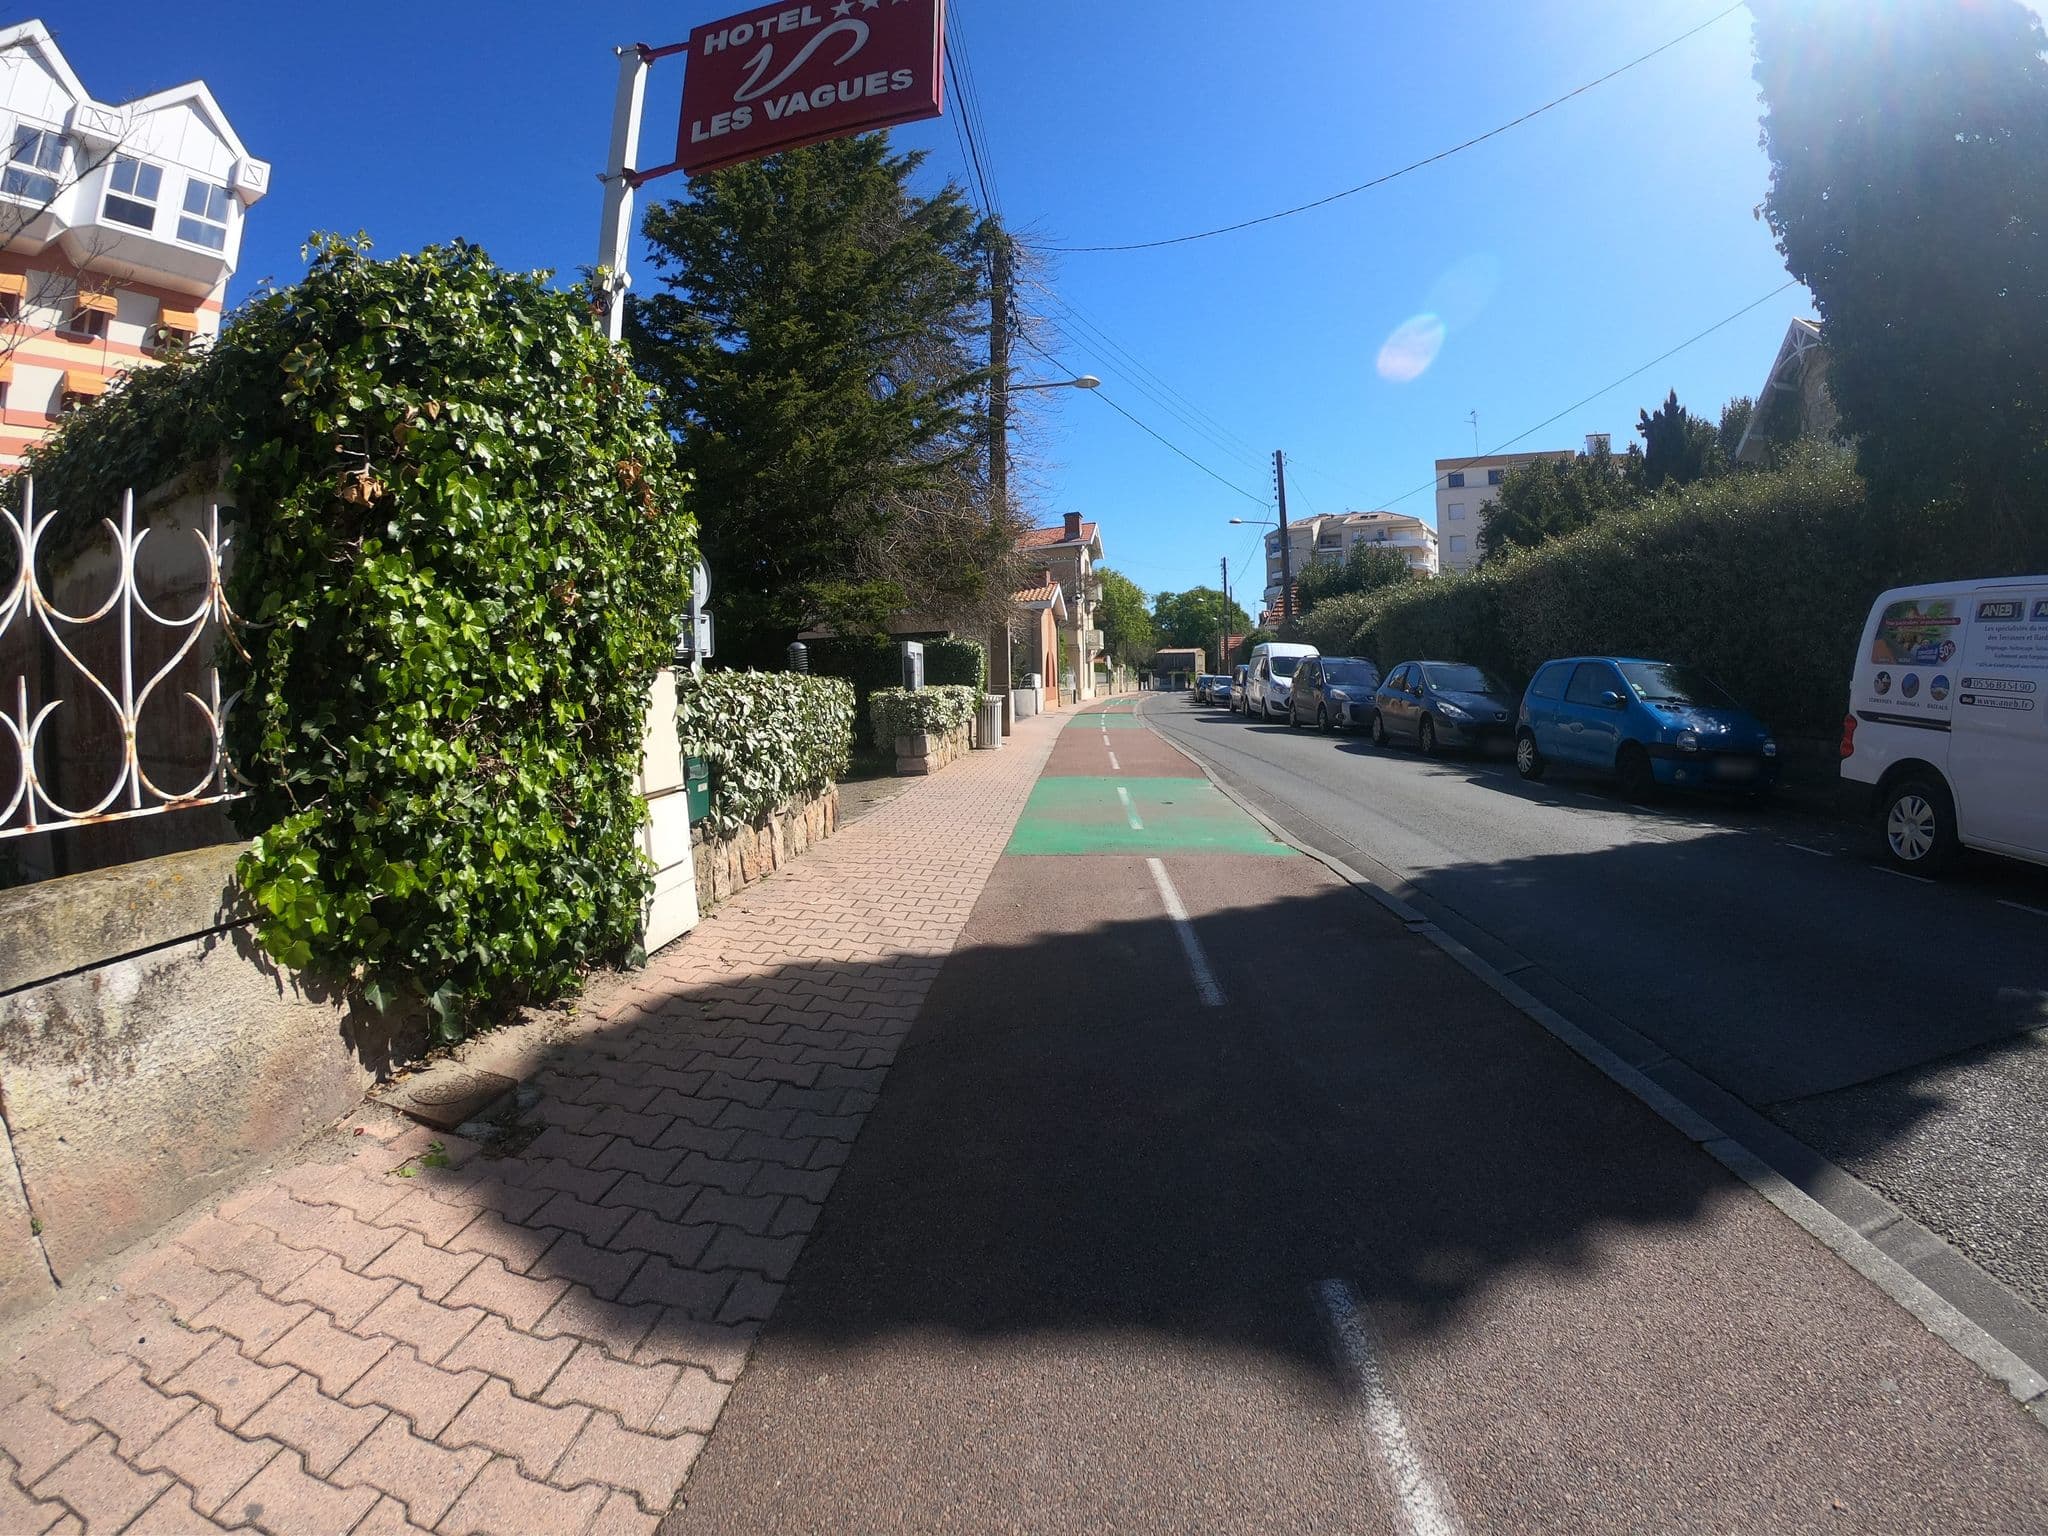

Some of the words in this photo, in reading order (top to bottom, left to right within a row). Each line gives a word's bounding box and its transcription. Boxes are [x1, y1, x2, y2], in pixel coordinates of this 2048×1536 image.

[703, 5, 822, 56] HOTEL
[691, 105, 753, 144] LES
[763, 68, 914, 122] VAGUES
[1981, 603, 2013, 617] ANEB
